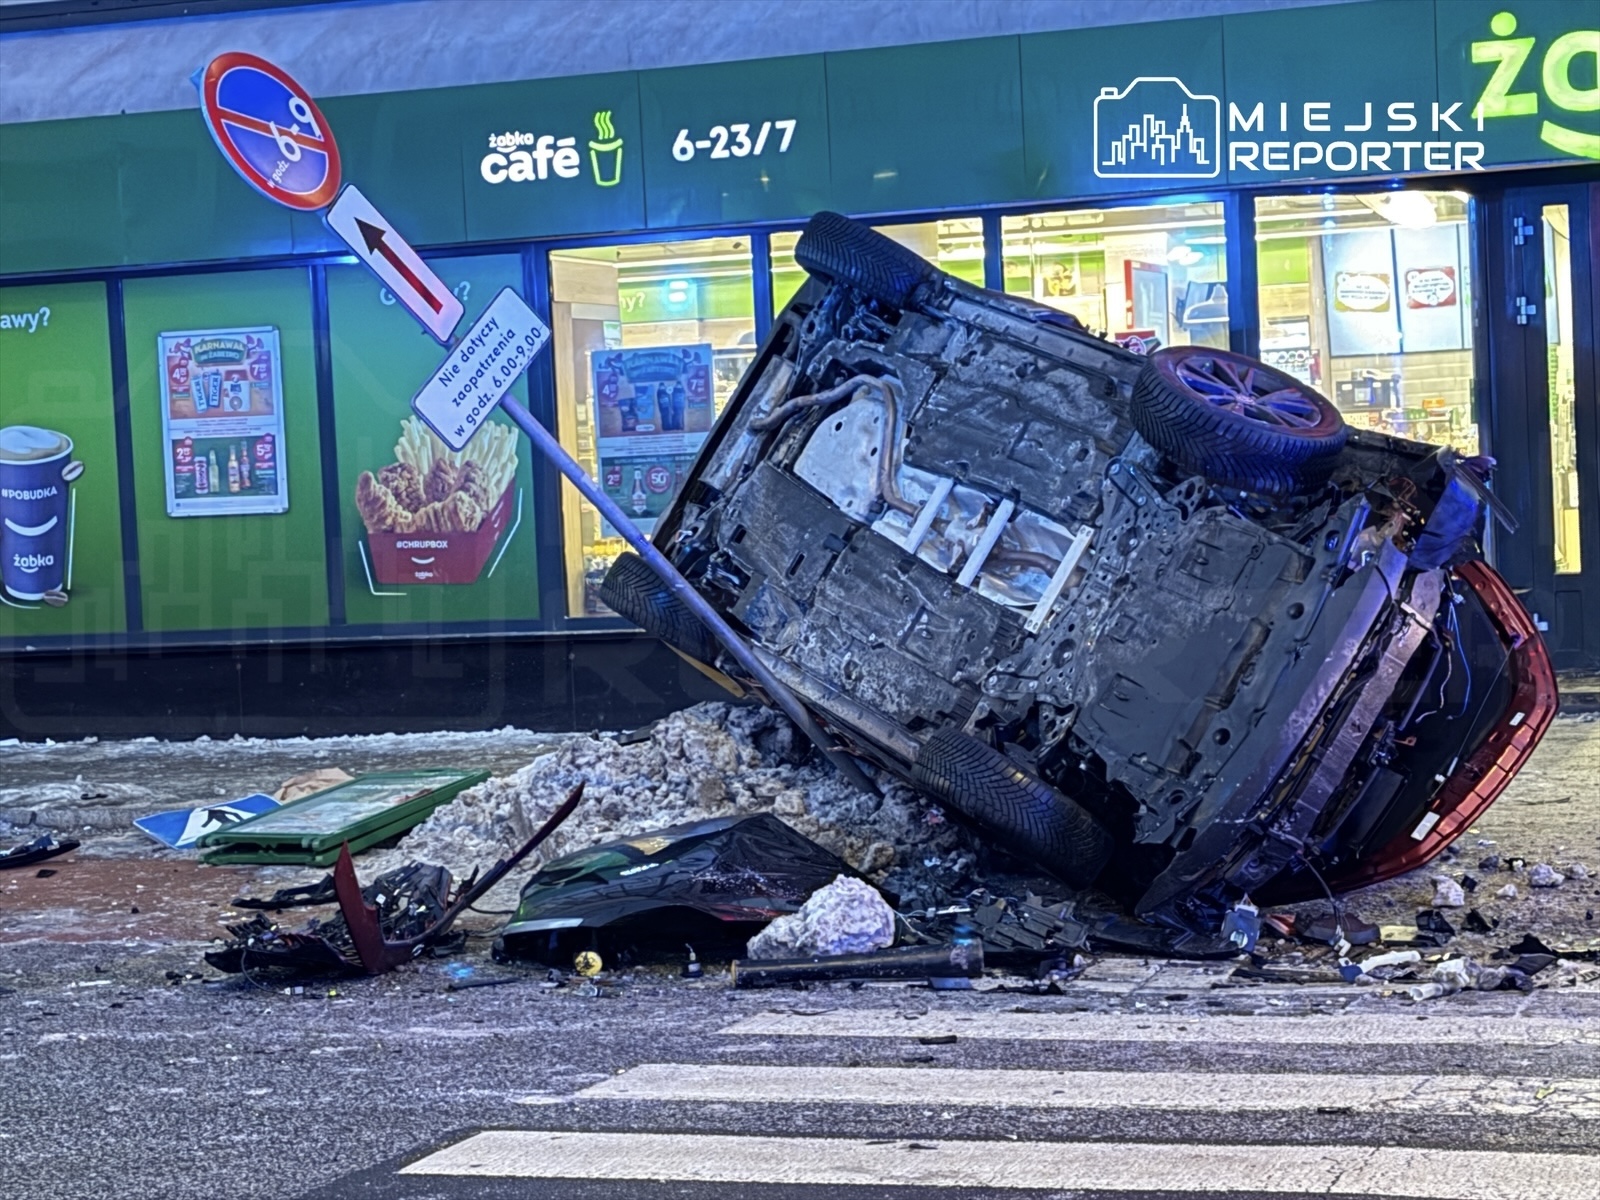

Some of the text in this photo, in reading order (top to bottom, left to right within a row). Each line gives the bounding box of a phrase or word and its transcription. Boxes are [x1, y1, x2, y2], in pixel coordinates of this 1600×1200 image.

[269, 96, 321, 162] 6-9
[488, 130, 535, 150] żabka
[672, 119, 797, 162] 6-23/7
[438, 316, 500, 388] Nie dotyczy
[451, 328, 516, 408] zaopatrzenia
[454, 326, 542, 437] w godz. 6.00-9.00
[1, 486, 58, 500] #POBUDKA
[13, 553, 54, 568] żabka
